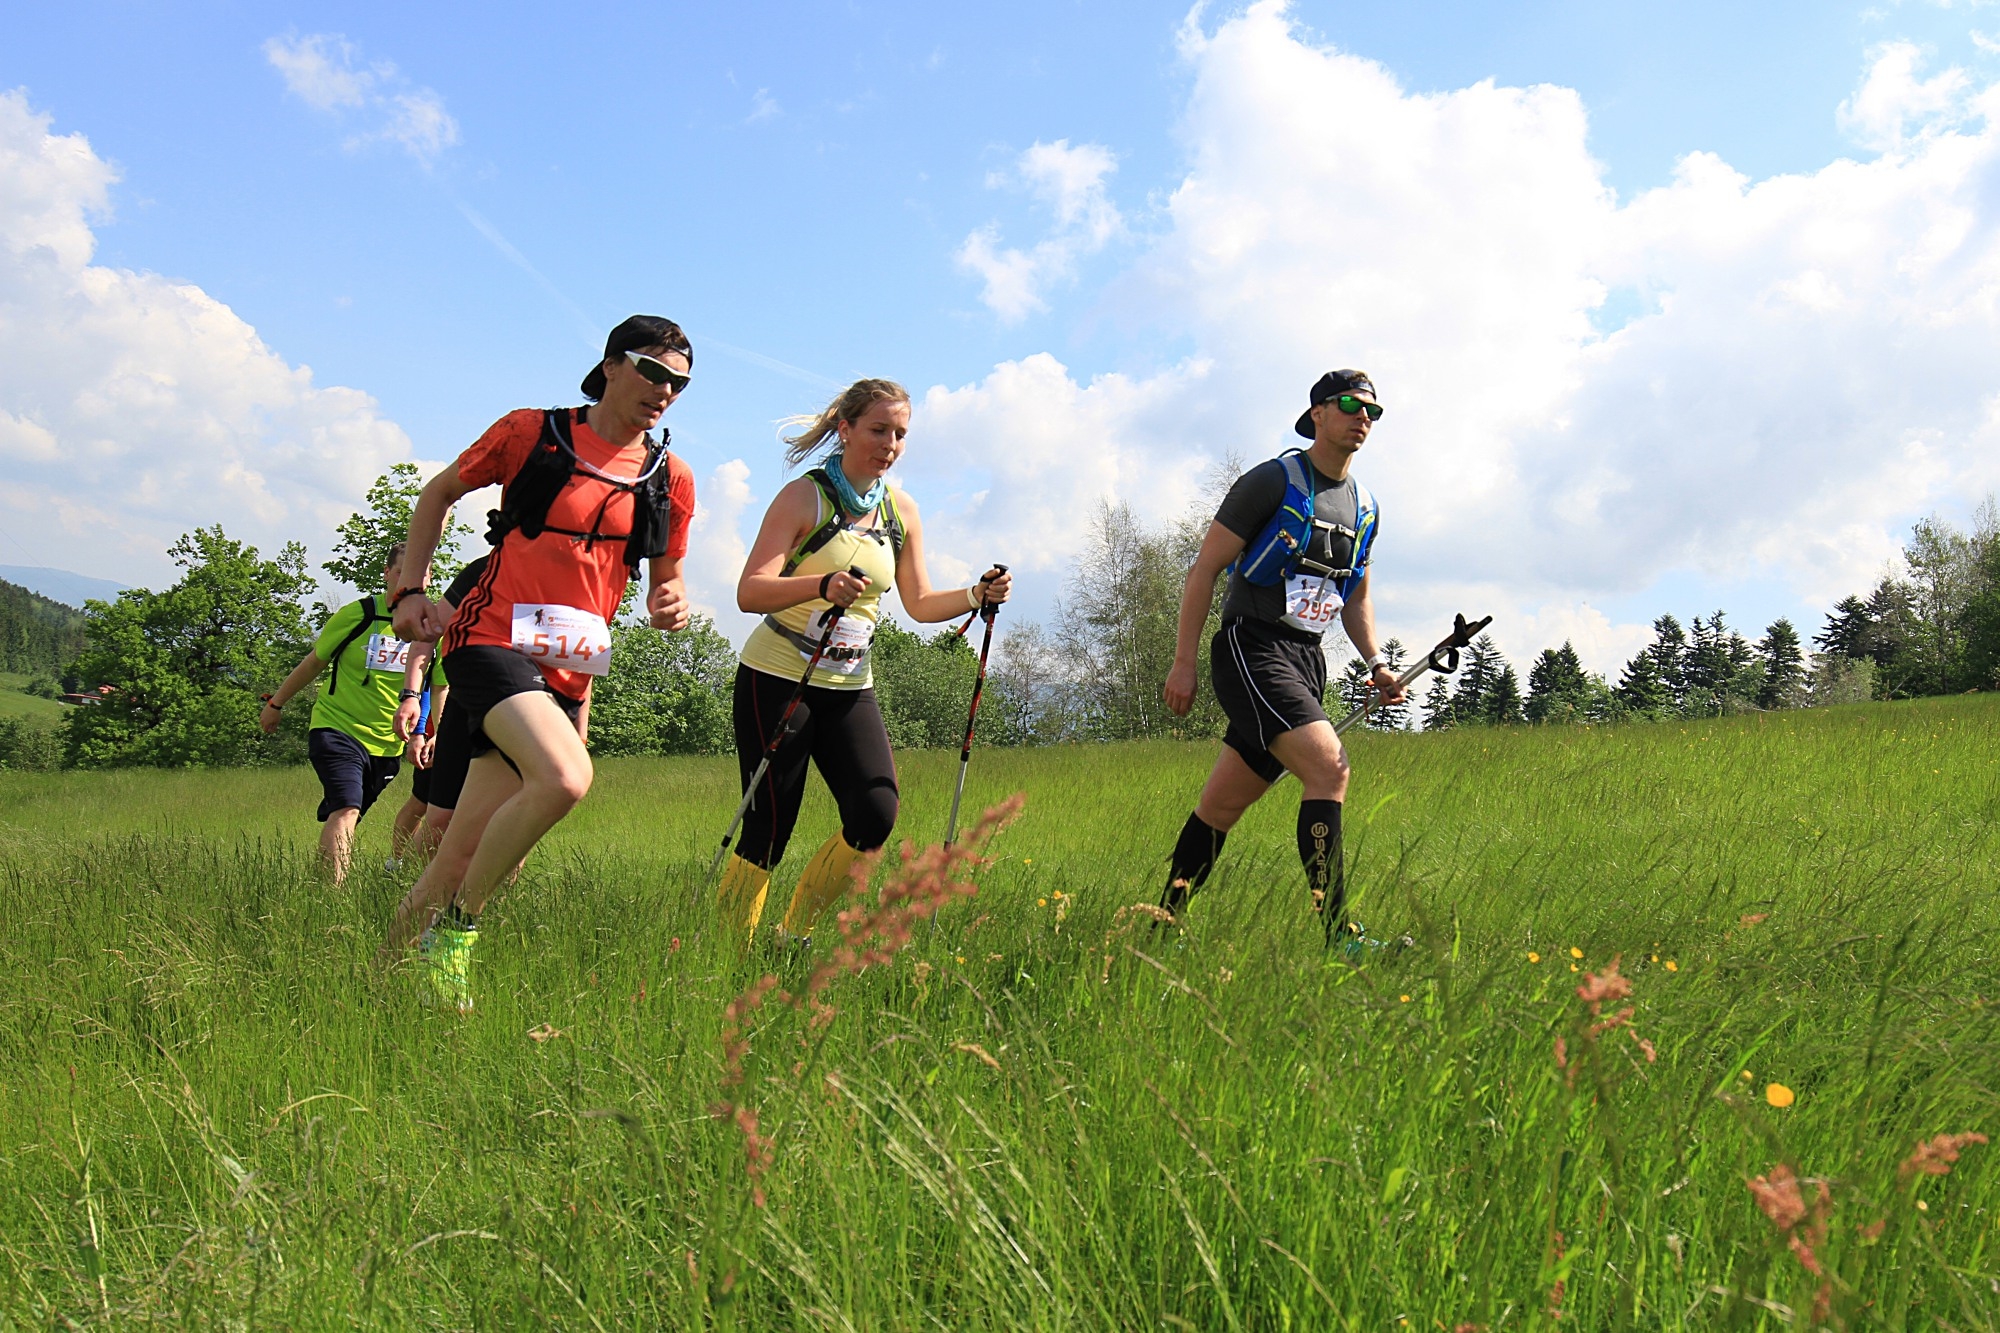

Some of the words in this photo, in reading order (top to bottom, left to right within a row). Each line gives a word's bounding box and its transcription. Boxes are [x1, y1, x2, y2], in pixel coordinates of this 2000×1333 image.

[1297, 597, 1332, 622] 295
[377, 650, 408, 665] 576
[531, 633, 593, 661] 514
[1315, 838, 1328, 884] SKINS
